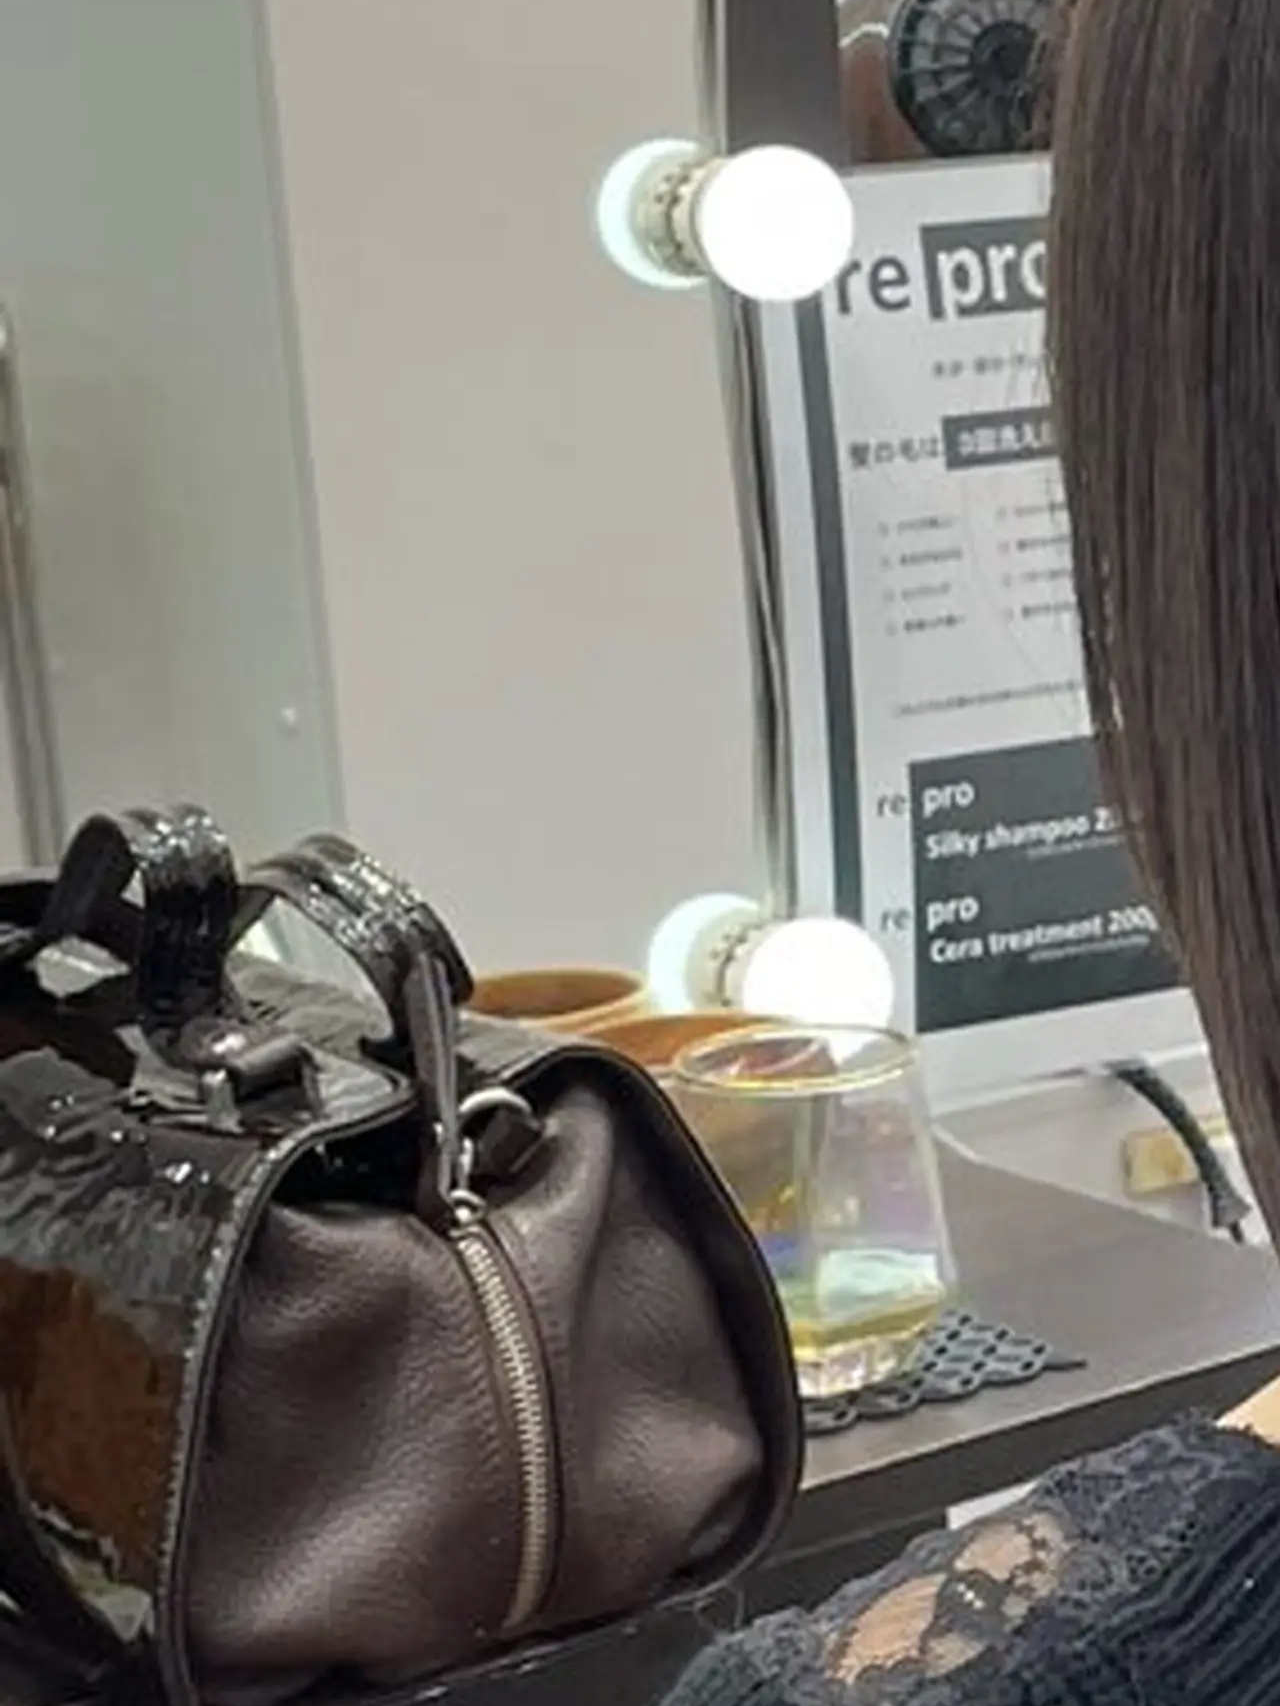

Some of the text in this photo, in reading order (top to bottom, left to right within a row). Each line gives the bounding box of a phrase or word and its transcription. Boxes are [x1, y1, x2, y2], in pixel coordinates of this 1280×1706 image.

[922, 781, 975, 818] pro
[926, 829, 979, 860] Silky
[985, 815, 1090, 850] shampoo
[926, 895, 979, 933] pro
[987, 915, 1103, 955] treatment
